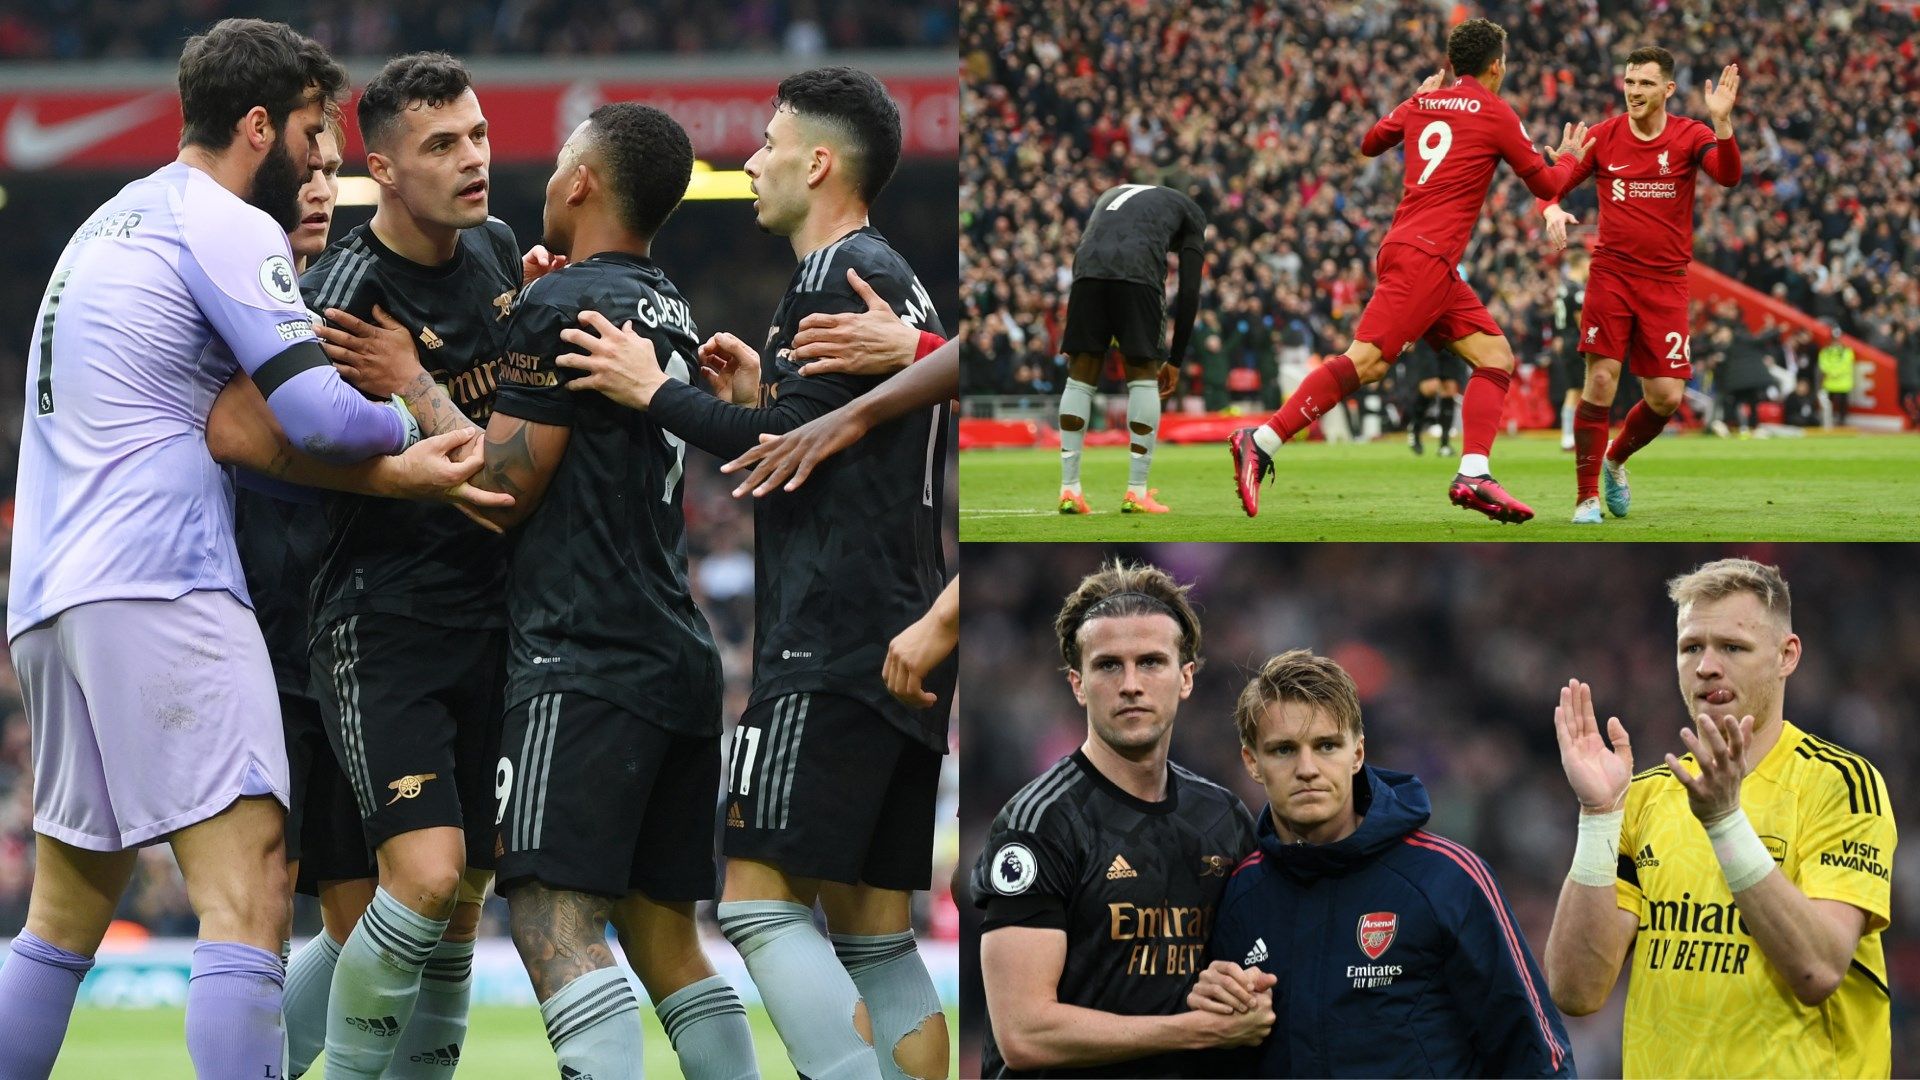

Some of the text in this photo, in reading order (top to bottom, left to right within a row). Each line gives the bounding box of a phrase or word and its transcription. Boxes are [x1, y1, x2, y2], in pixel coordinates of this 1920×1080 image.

[1418, 97, 1481, 113] FIRMINO
[1417, 120, 1453, 185] 9
[1628, 181, 1676, 191] standard
[1628, 190, 1677, 198] chartered
[1105, 183, 1157, 211] 7
[275, 321, 292, 333] No
[36, 268, 72, 418] 1
[506, 350, 540, 370] VISIT
[728, 724, 762, 797] 11
[494, 756, 514, 826] 9
[1841, 839, 1881, 860] VISIT
[1106, 868, 1138, 881] adidas
[1819, 851, 1890, 883] RWANDA
[1364, 919, 1395, 929] Arsenal
[1672, 939, 1751, 975] BETTER
[1346, 963, 1403, 978] Emirates
[1352, 975, 1394, 989] FLY BETTER
